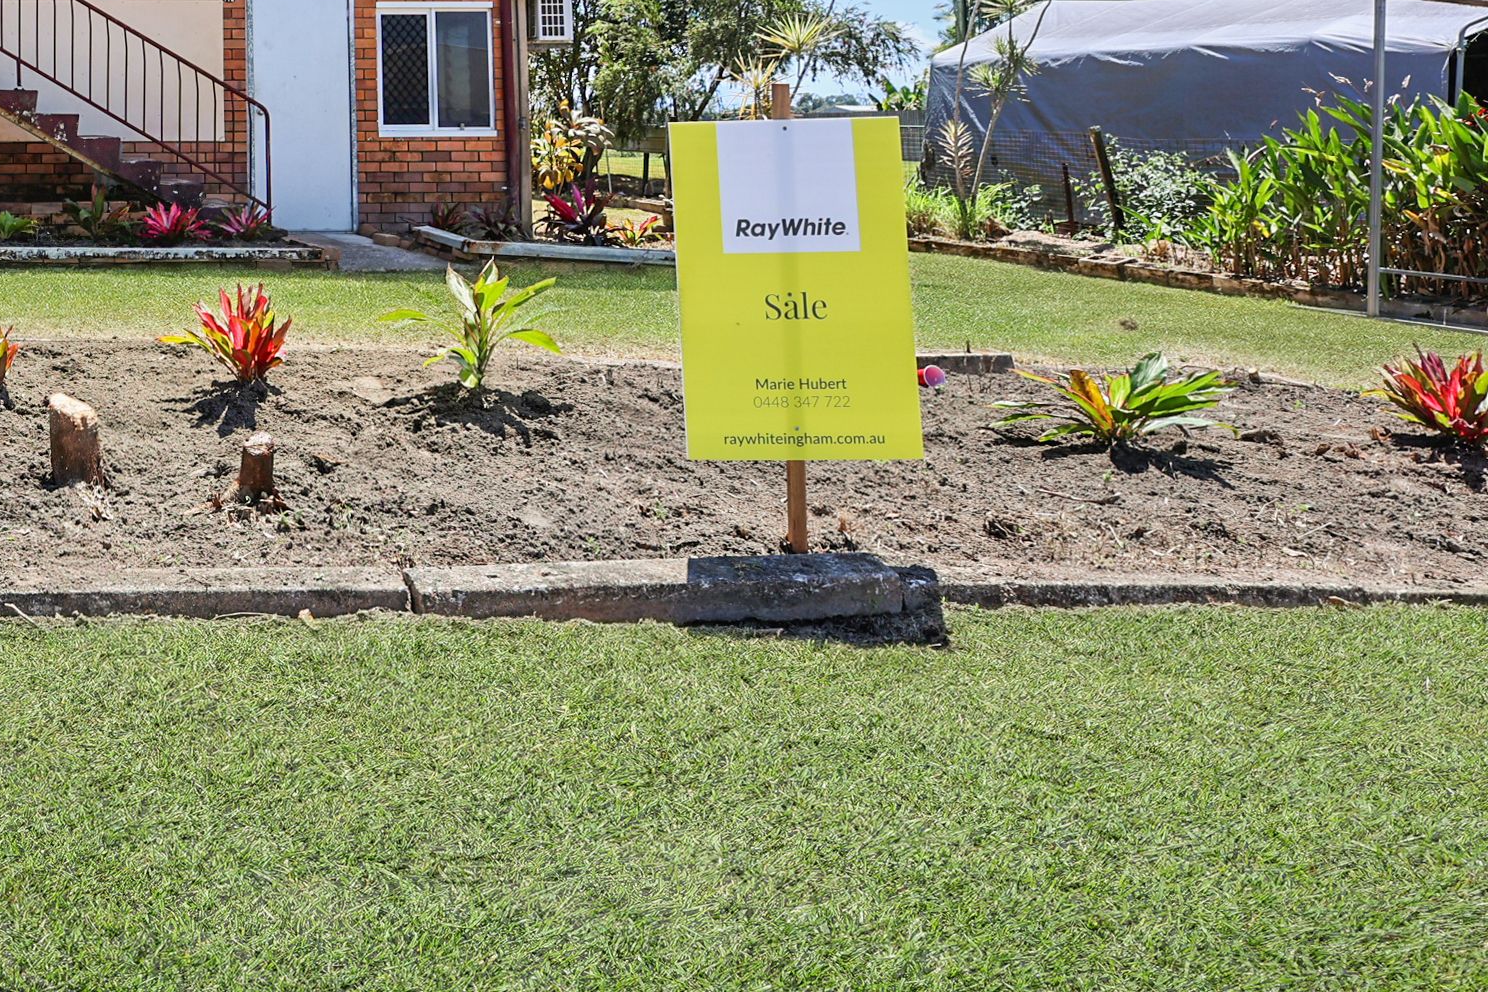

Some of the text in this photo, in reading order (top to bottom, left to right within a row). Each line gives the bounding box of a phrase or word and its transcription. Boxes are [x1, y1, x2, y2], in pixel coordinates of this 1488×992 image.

[764, 291, 828, 320] Sale
[755, 378, 847, 390] Marie Hubert
[753, 395, 851, 408] 0448 347 722
[724, 432, 885, 447] raywhiteingham.com.au
